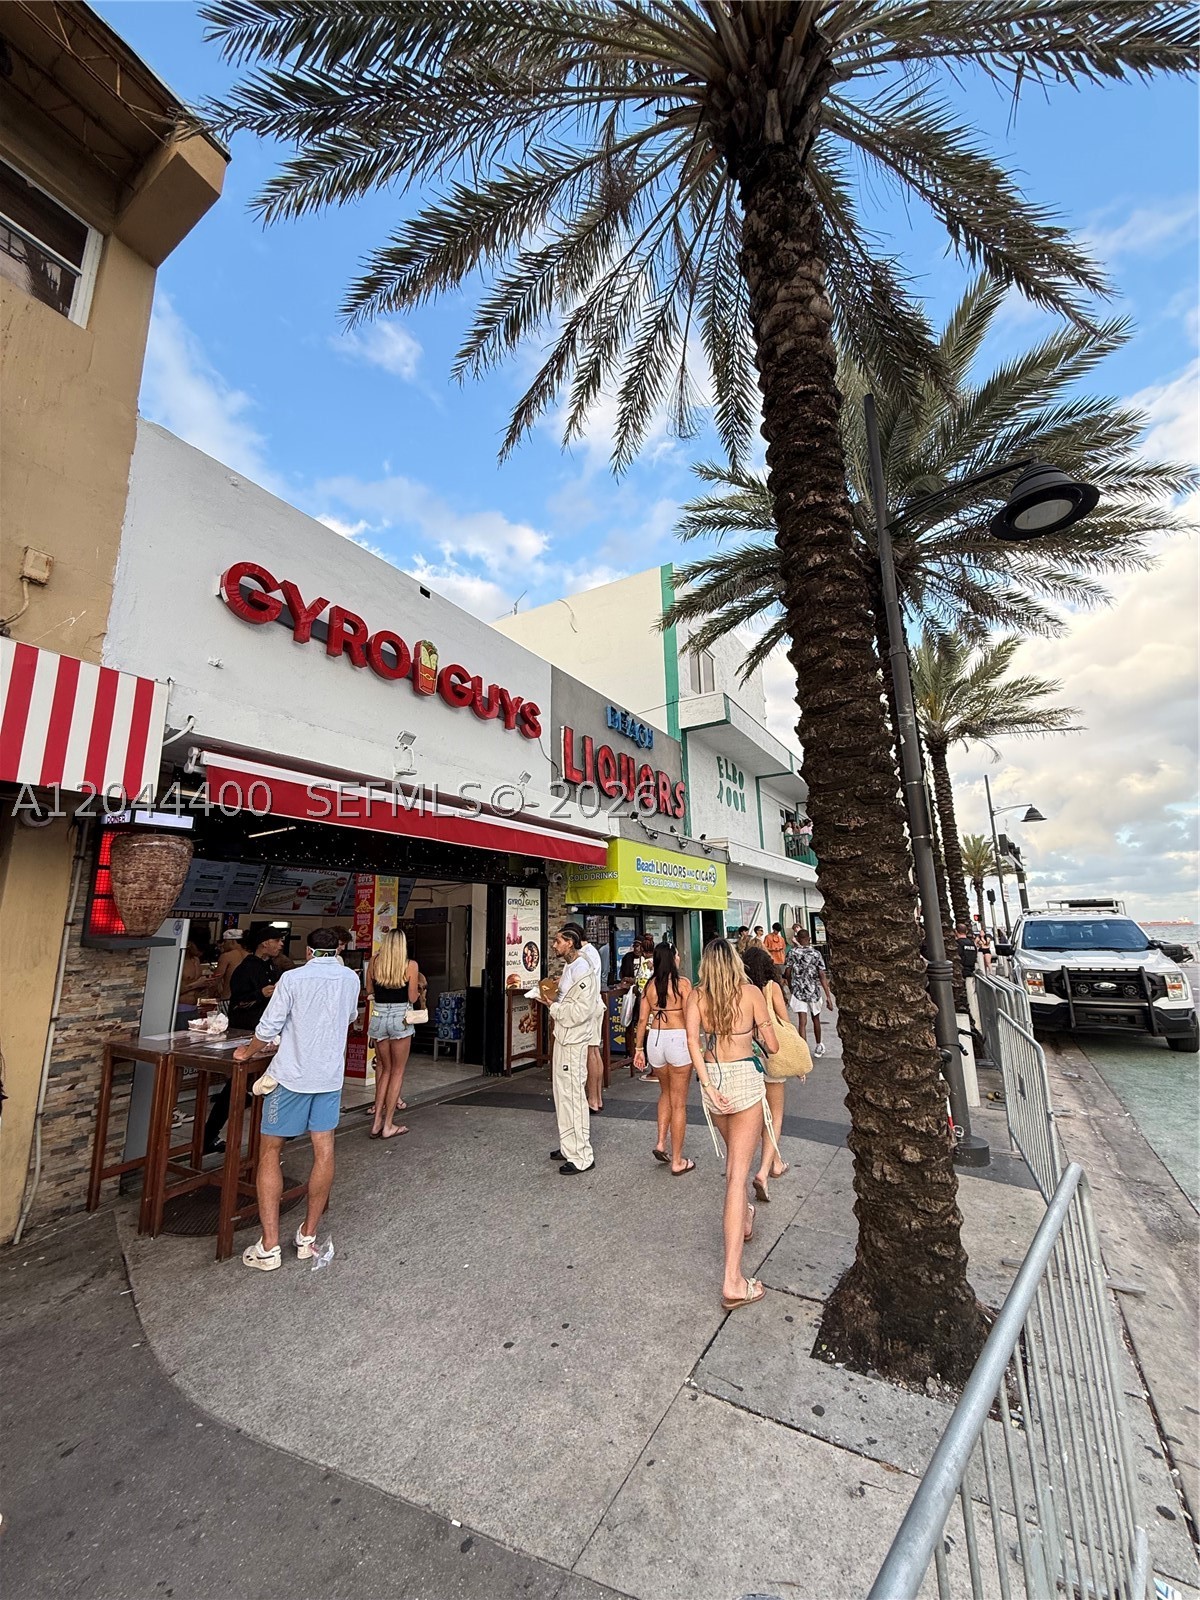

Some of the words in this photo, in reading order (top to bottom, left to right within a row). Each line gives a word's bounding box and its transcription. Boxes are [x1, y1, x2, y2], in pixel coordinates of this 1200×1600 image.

[216, 561, 412, 680] GYRO
[438, 664, 542, 739] GUYS
[606, 704, 654, 750] BEACH
[561, 726, 686, 819] LIQUORS
[716, 756, 745, 791] ELBO
[569, 873, 589, 882] COLD
[590, 871, 618, 880] DRINKS
[636, 858, 655, 873] Beach
[656, 862, 687, 879] LIQUORS
[695, 869, 716, 883] CIGARS
[651, 877, 664, 887] COLD
